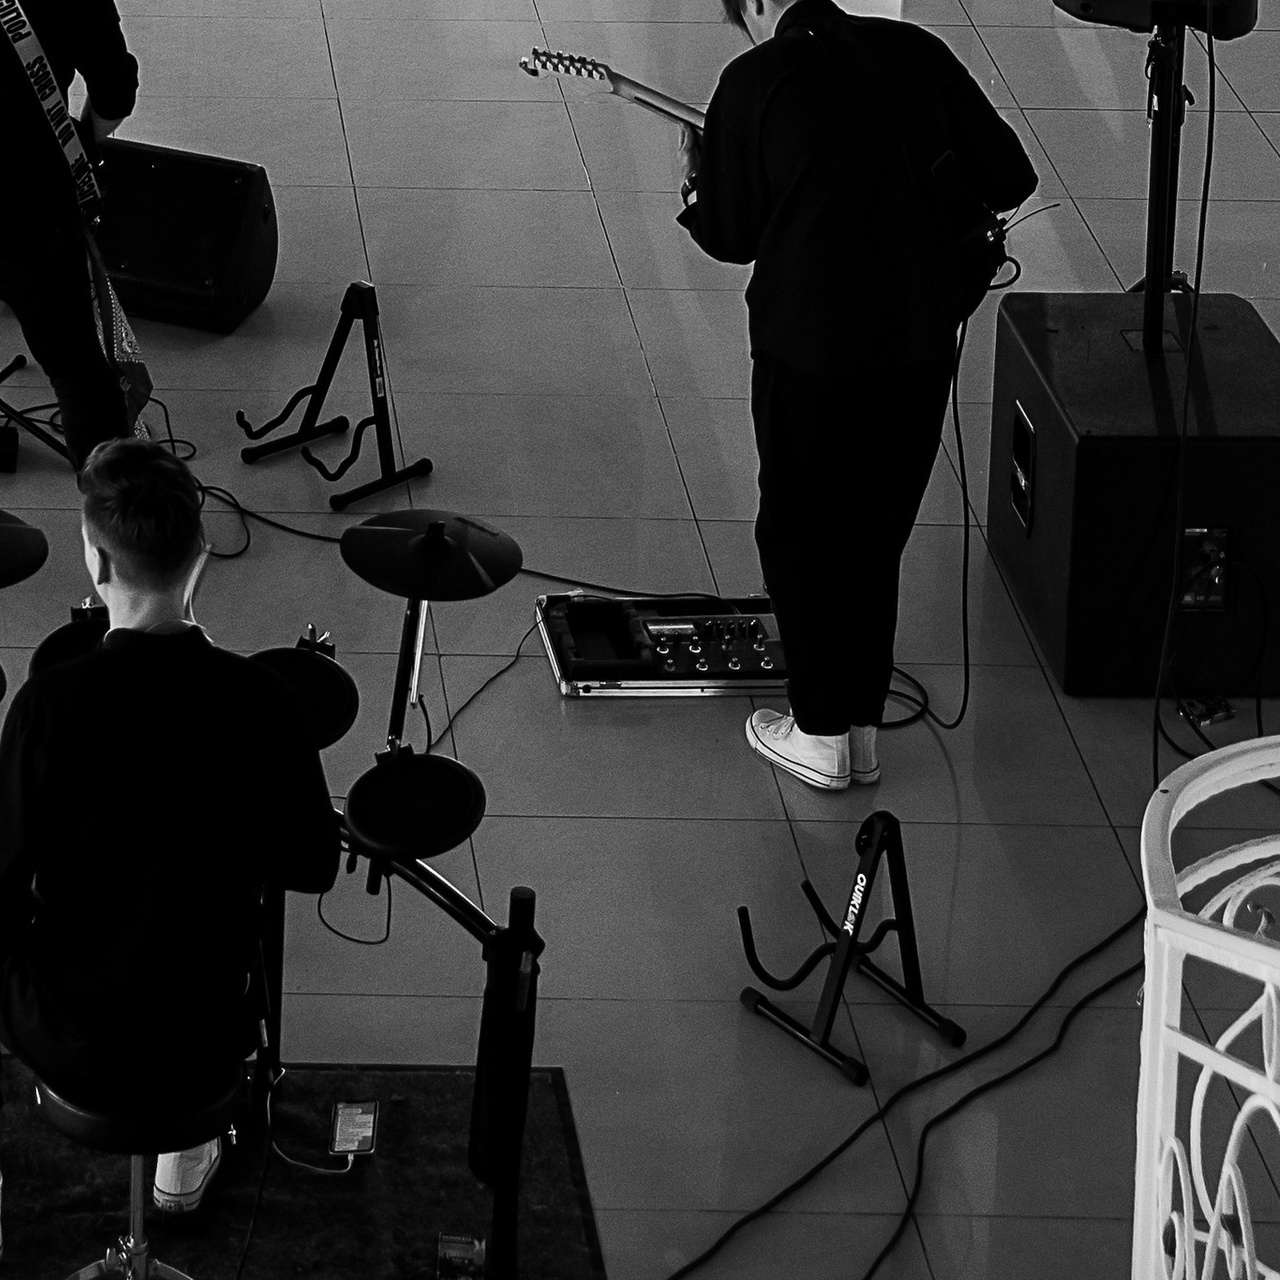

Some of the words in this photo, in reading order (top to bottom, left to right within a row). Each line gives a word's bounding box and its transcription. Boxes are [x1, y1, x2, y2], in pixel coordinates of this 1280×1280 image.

[25, 55, 57, 102] CROSS
[46, 99, 68, 132] NOT
[58, 123, 76, 149] DO
